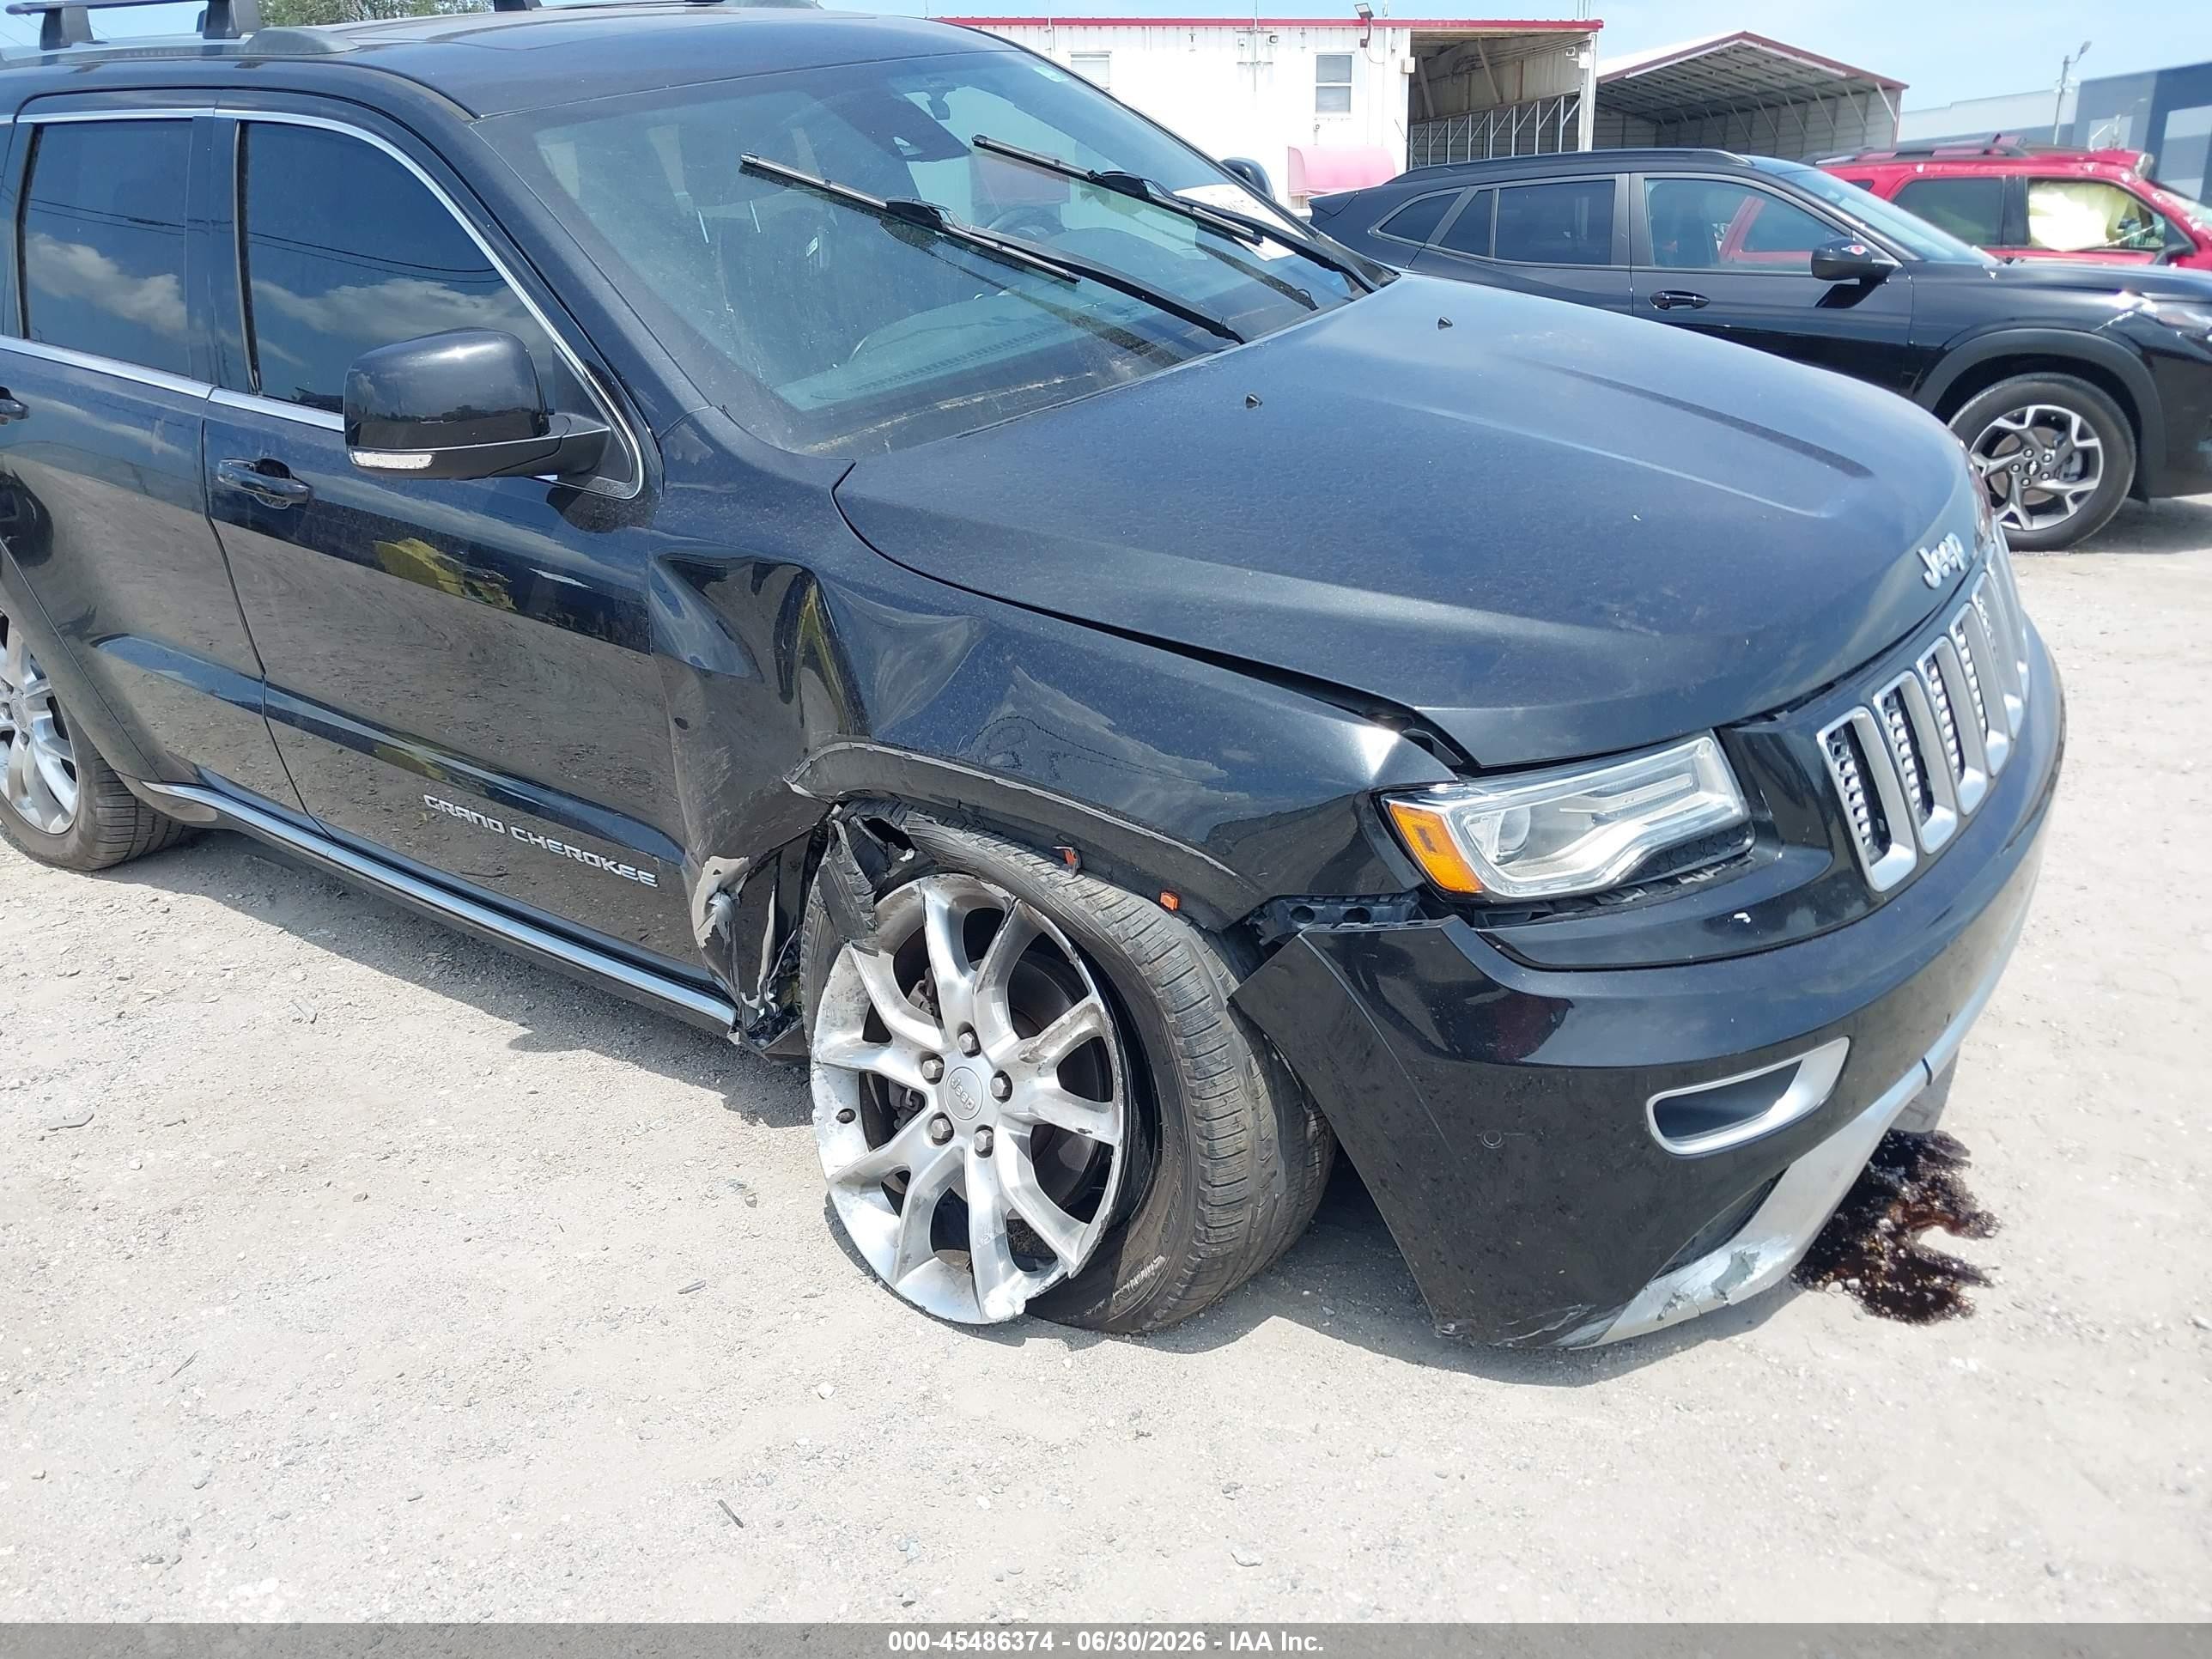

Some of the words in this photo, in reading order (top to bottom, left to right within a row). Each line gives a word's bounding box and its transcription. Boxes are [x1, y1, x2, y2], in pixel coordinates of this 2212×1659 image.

[1917, 532, 1966, 588] Jeep
[422, 793, 506, 834] GRAND
[510, 825, 659, 888] CHEROKEE
[950, 1077, 975, 1111] Jeep
